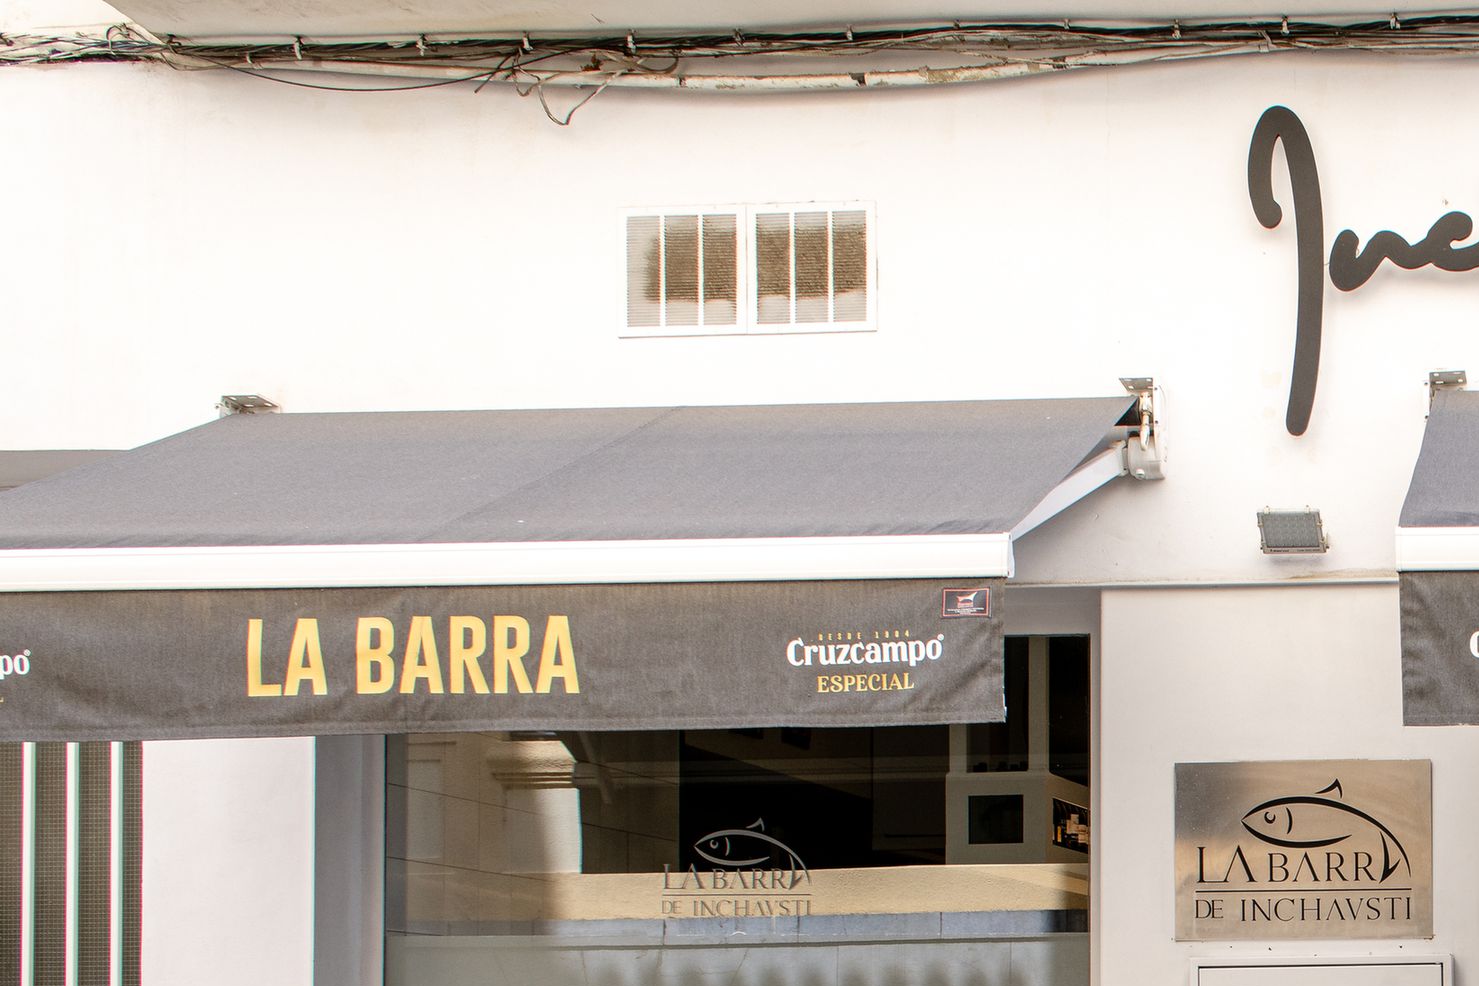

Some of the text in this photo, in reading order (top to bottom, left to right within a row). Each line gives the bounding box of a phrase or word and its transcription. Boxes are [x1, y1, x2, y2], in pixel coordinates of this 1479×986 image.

[246, 614, 580, 698] LA BARRA
[786, 636, 943, 667] Cruzcampo
[816, 672, 915, 693] ESPECIAL
[662, 863, 706, 890] LA
[1196, 845, 1257, 884] LA
[661, 899, 683, 915] DE
[1195, 898, 1224, 920] DE
